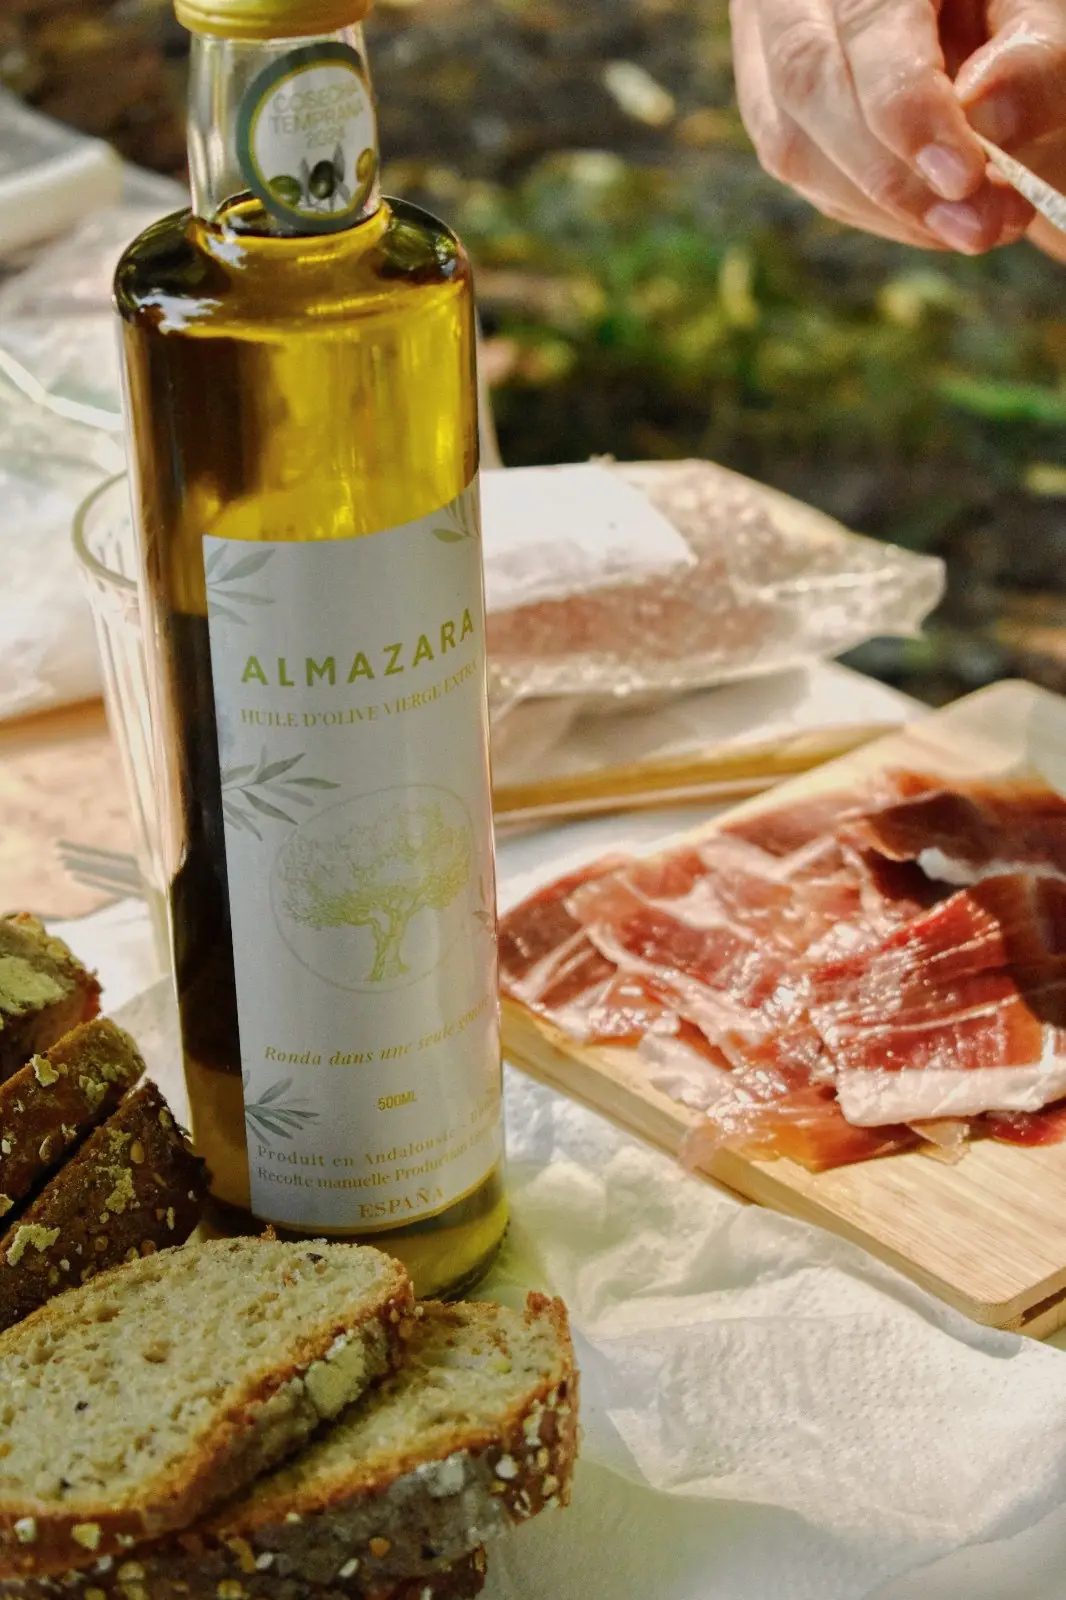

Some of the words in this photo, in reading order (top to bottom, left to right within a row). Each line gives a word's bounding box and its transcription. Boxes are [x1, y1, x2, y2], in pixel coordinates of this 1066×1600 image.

[240, 607, 475, 687] ALMAZARA
[240, 708, 299, 727] HUILE
[303, 705, 379, 728] D'OLIVE
[382, 682, 442, 716] VIERGE
[264, 1045, 322, 1066] Ronda
[328, 1050, 374, 1067] dans
[379, 1043, 413, 1060] une
[377, 1090, 418, 1112] 500ML
[258, 1144, 324, 1167] Produit
[333, 1156, 354, 1167] en
[364, 1128, 454, 1166] Andalousie
[317, 1172, 391, 1190] manuelle
[359, 1186, 445, 1219] ESPAÑA
